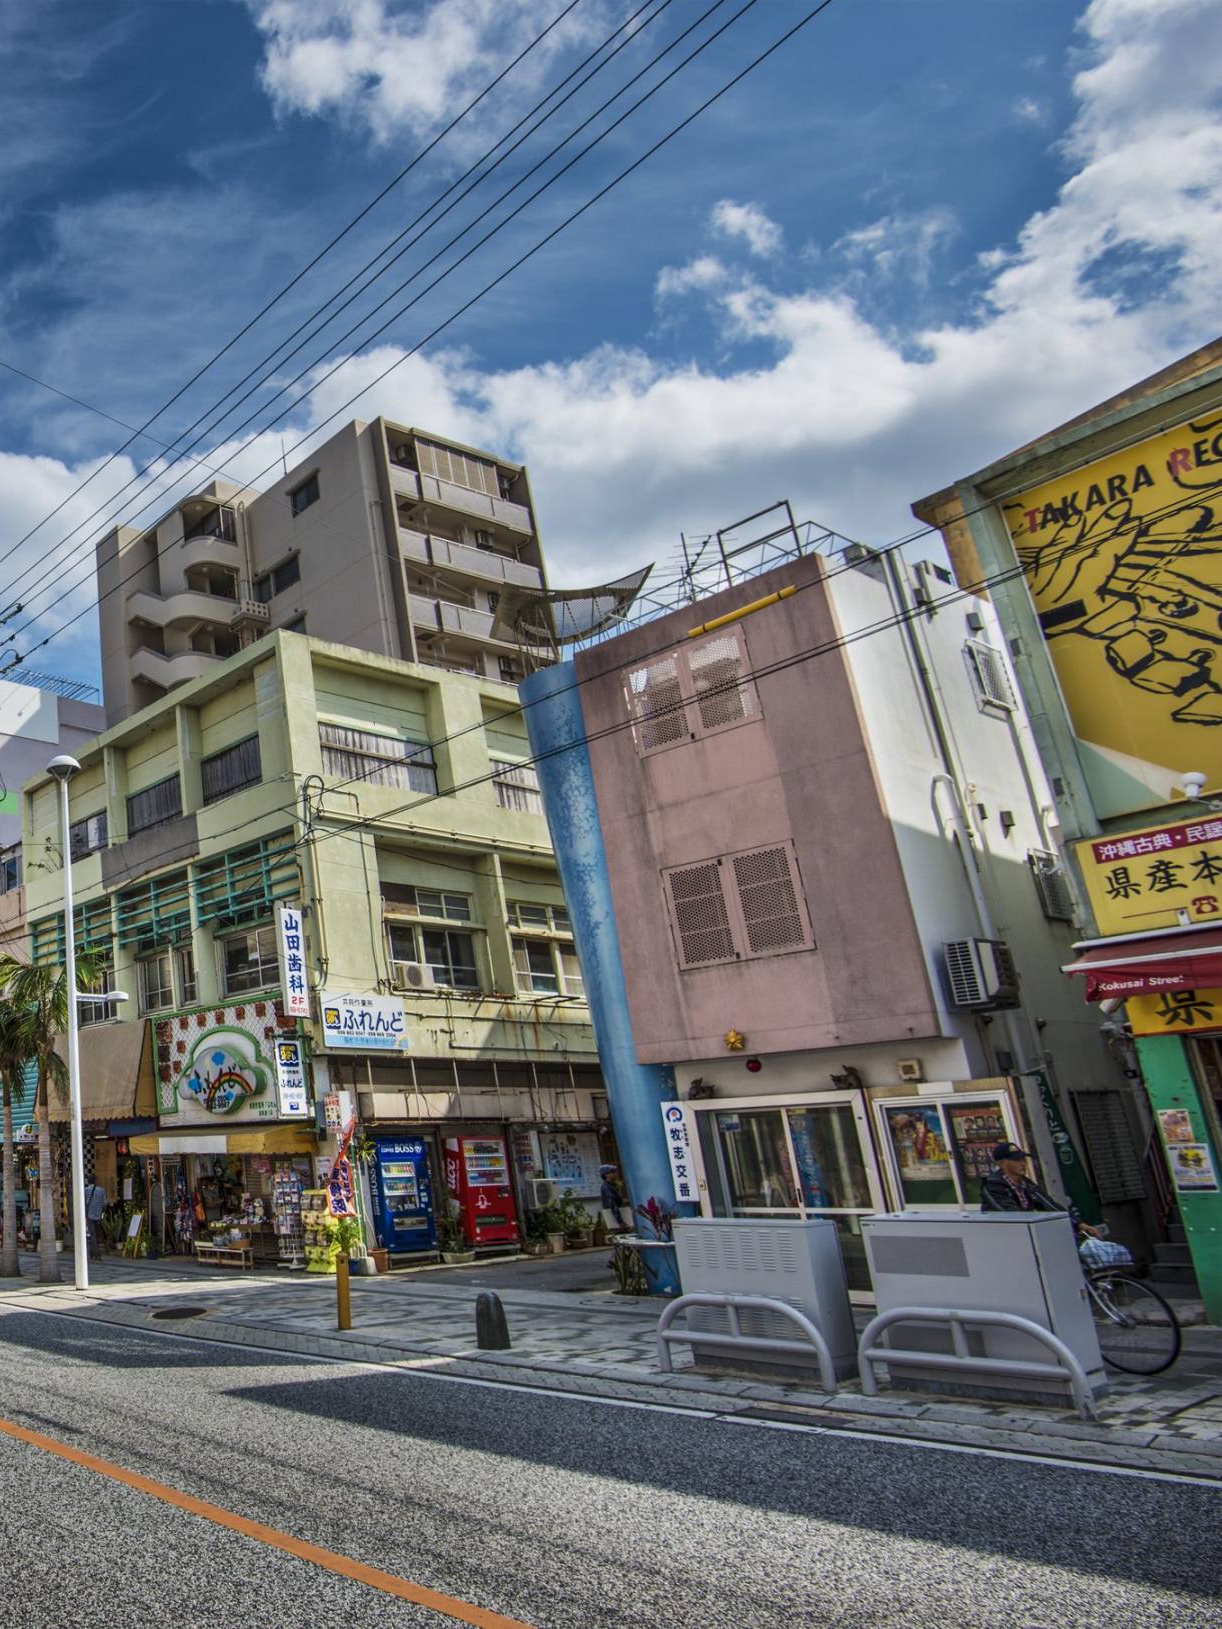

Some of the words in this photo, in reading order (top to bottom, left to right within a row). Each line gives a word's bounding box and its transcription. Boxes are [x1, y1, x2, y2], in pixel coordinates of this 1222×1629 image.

[1023, 464, 1156, 534] TAKARA
[283, 912, 305, 995] 山田歯科
[290, 995, 305, 1006] 2F
[342, 1009, 404, 1033] ふれんど
[394, 1143, 414, 1153] BOSS
[669, 1127, 690, 1197] 牧志交番
[445, 1157, 456, 1190] UCC
